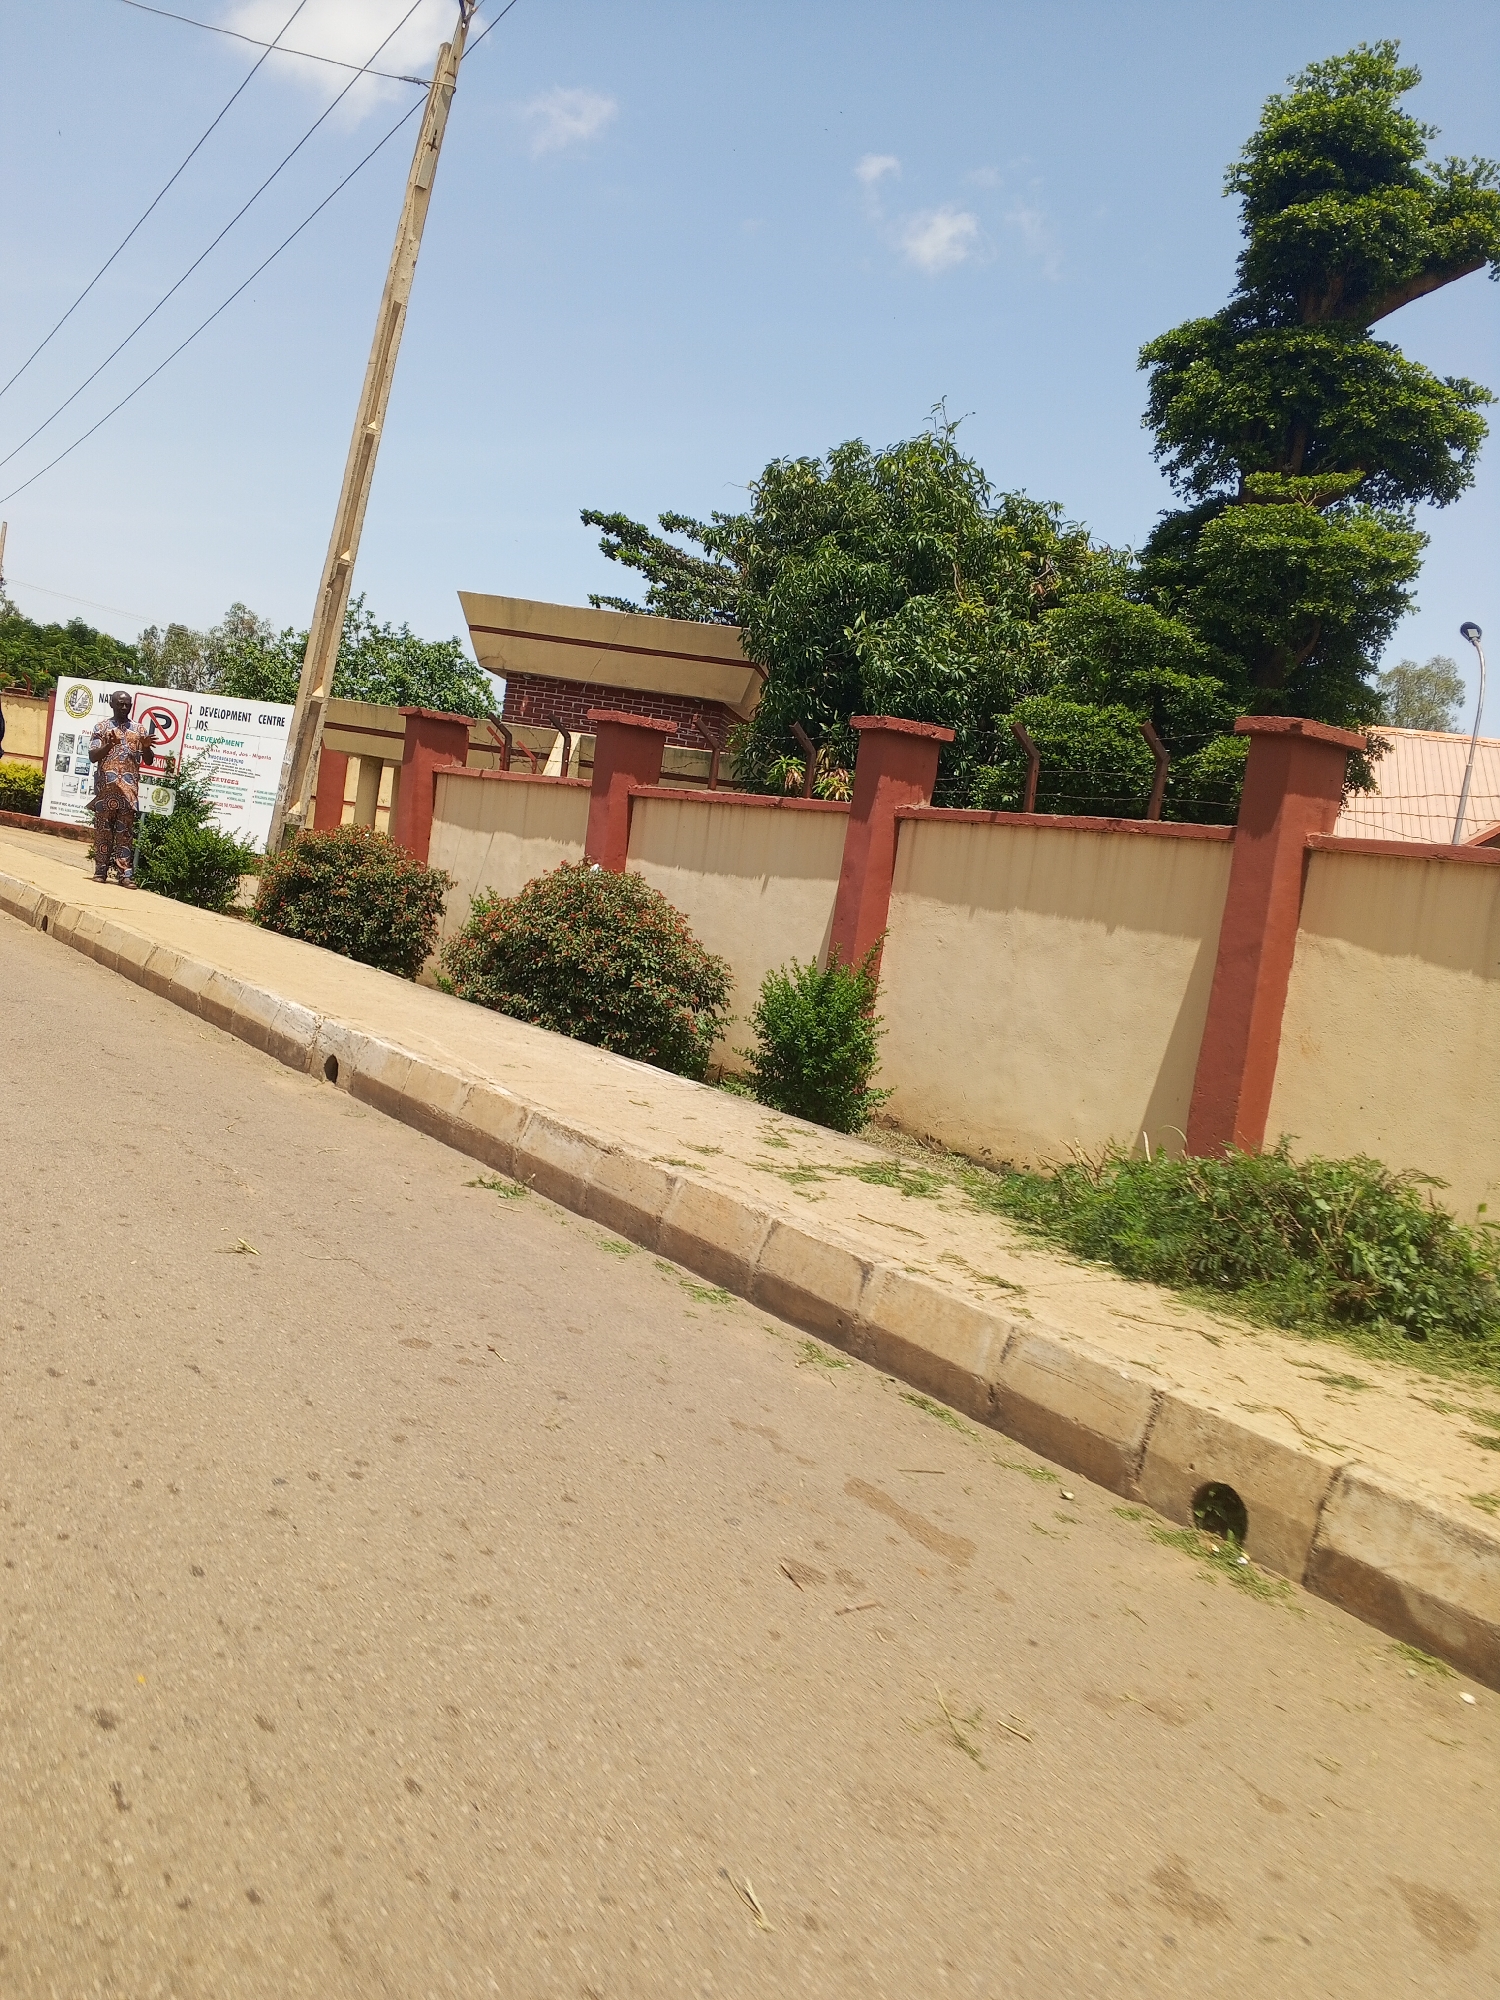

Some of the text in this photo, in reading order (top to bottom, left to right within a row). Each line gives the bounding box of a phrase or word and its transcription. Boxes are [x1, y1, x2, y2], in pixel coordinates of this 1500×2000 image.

[149, 712, 172, 737] P
[196, 719, 209, 731] JOS
[200, 706, 252, 722] DEVELOPMENT
[258, 714, 286, 727] CENTRE
[196, 735, 244, 748] DEVELOPMENT
